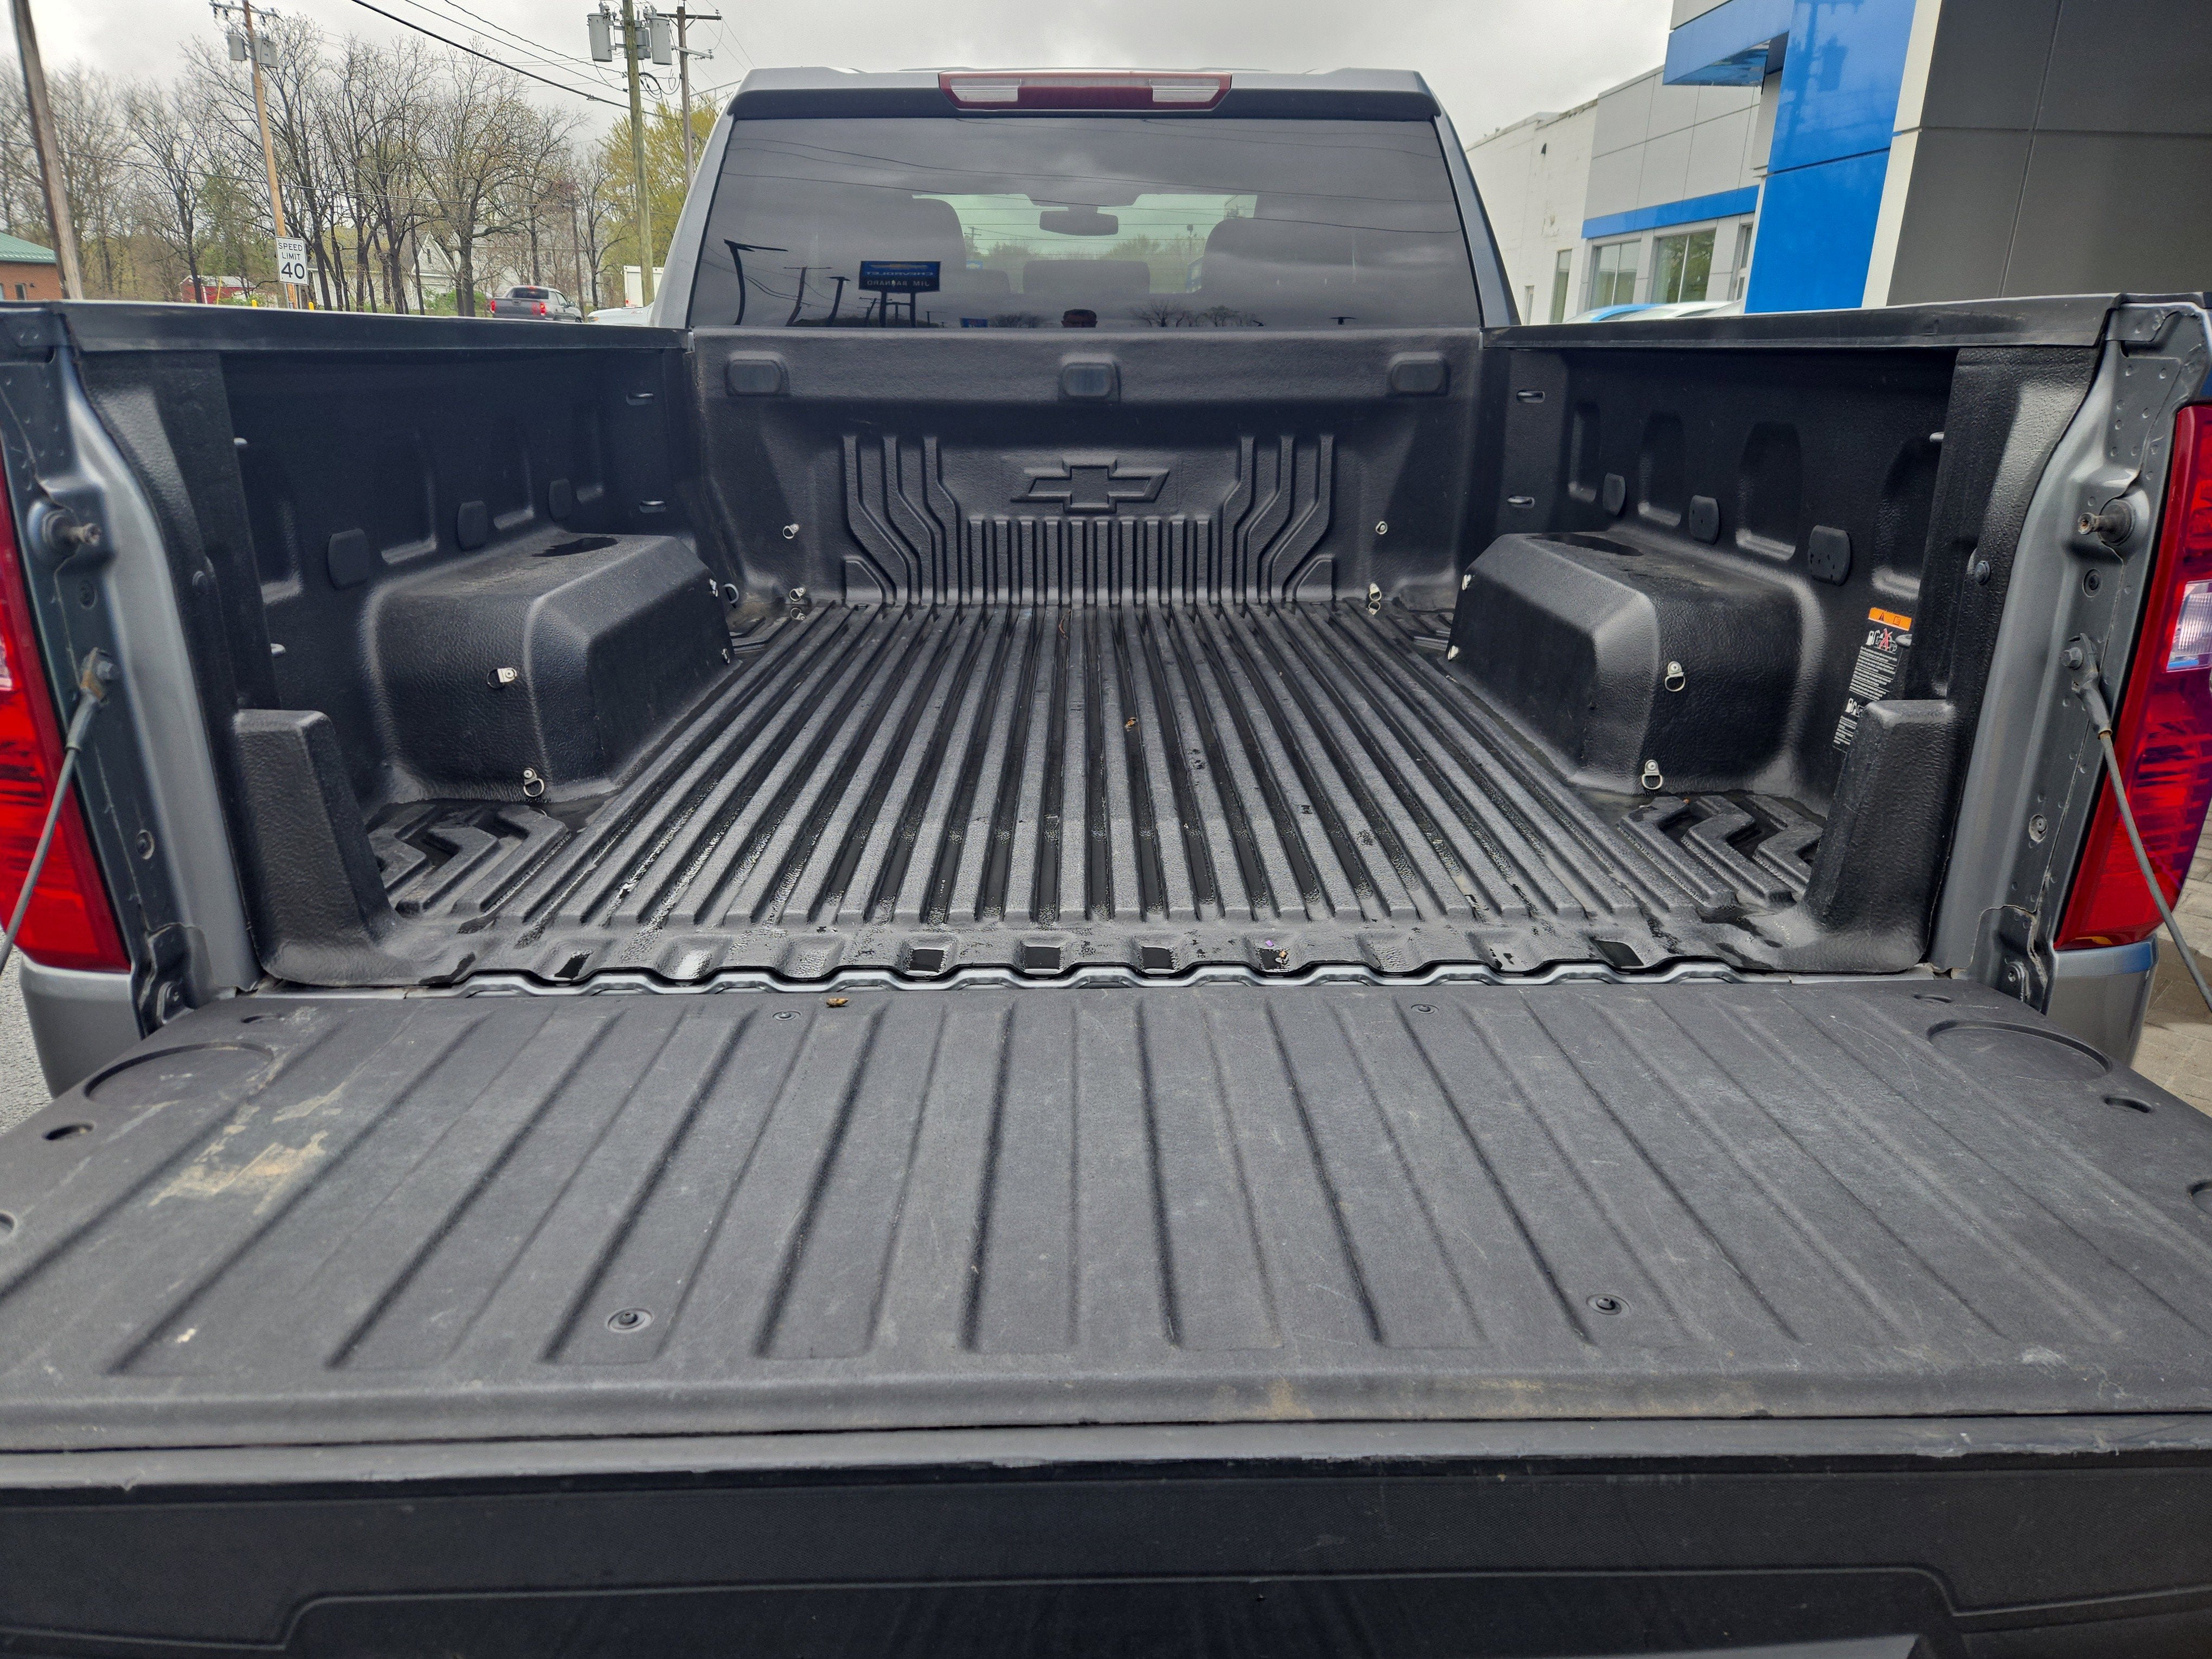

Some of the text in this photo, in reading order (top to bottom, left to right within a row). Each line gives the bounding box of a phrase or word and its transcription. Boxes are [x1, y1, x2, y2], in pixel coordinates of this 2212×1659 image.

[278, 242, 303, 251] SPEED
[282, 252, 300, 260] LIMIT
[281, 262, 305, 279] 40
